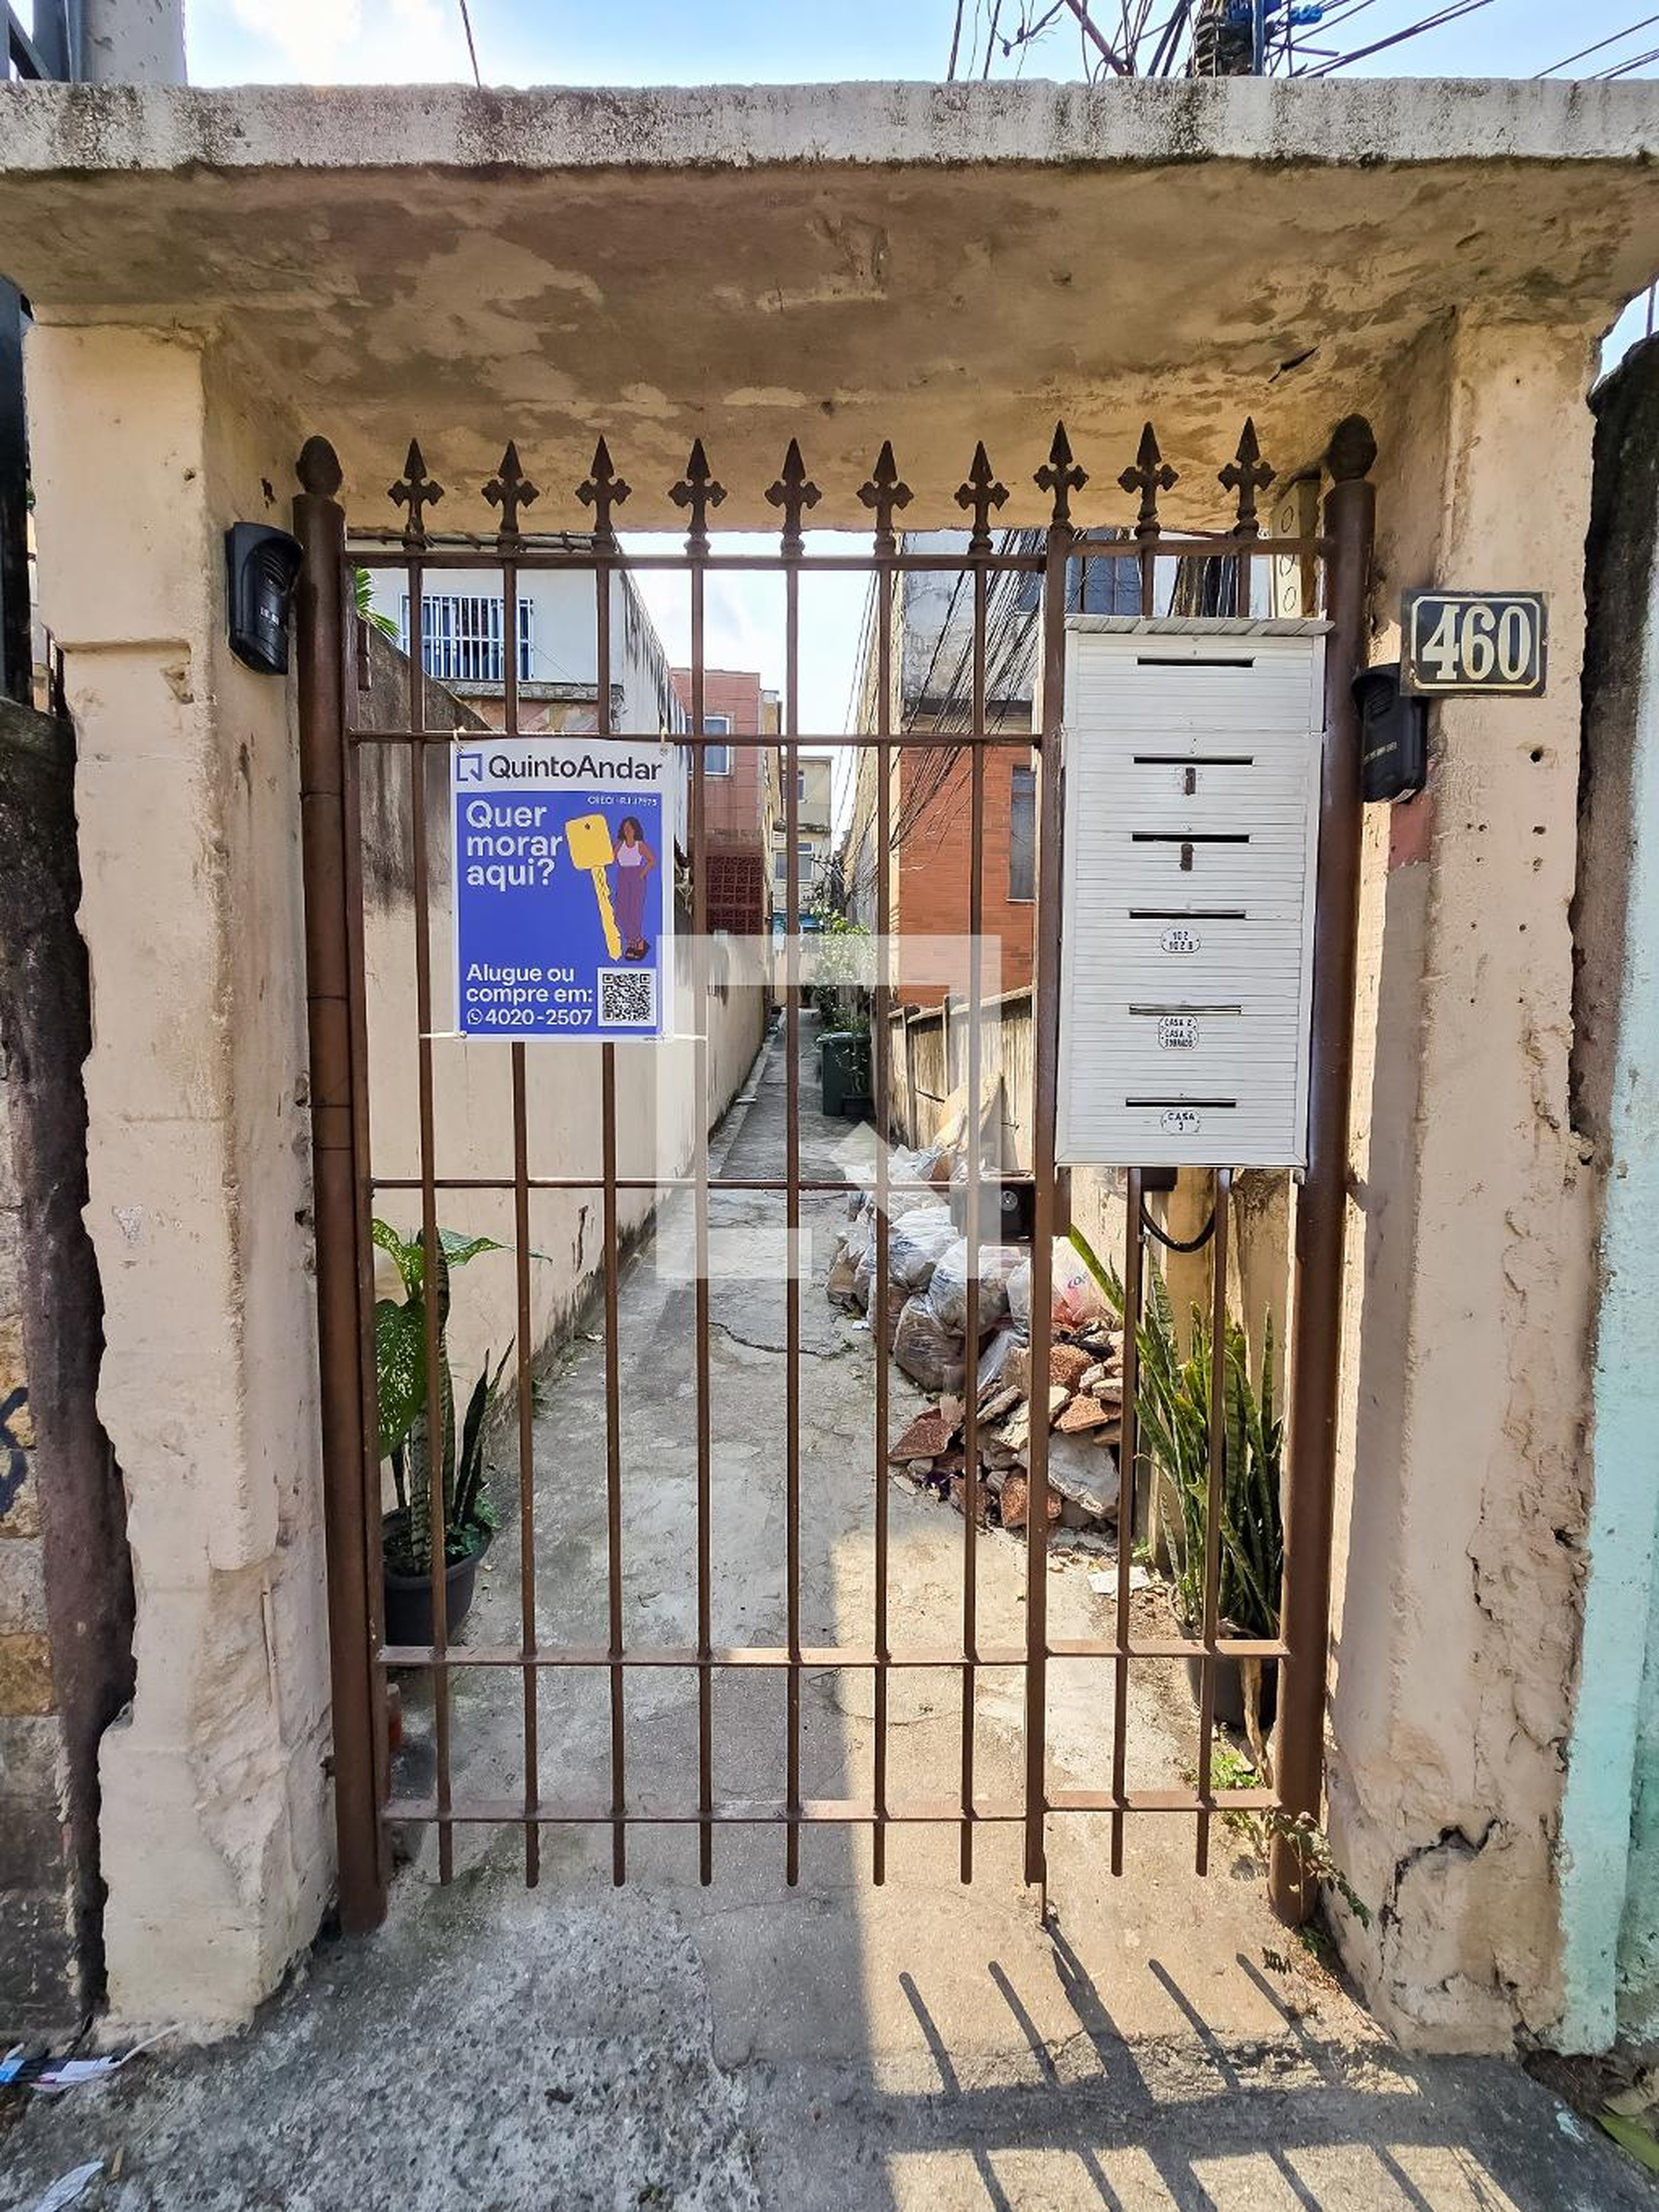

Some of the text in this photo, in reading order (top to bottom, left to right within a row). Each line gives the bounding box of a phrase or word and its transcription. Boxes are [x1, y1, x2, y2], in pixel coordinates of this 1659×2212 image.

[1422, 604, 1532, 681] 460
[488, 755, 662, 780] QuintoAndar
[466, 800, 547, 828] Quer
[467, 835, 563, 856] morar
[466, 858, 555, 892] aqui?
[466, 964, 574, 986] Alugue ou
[466, 987, 593, 1006] compre em:
[485, 1009, 592, 1025] 4020-2507
